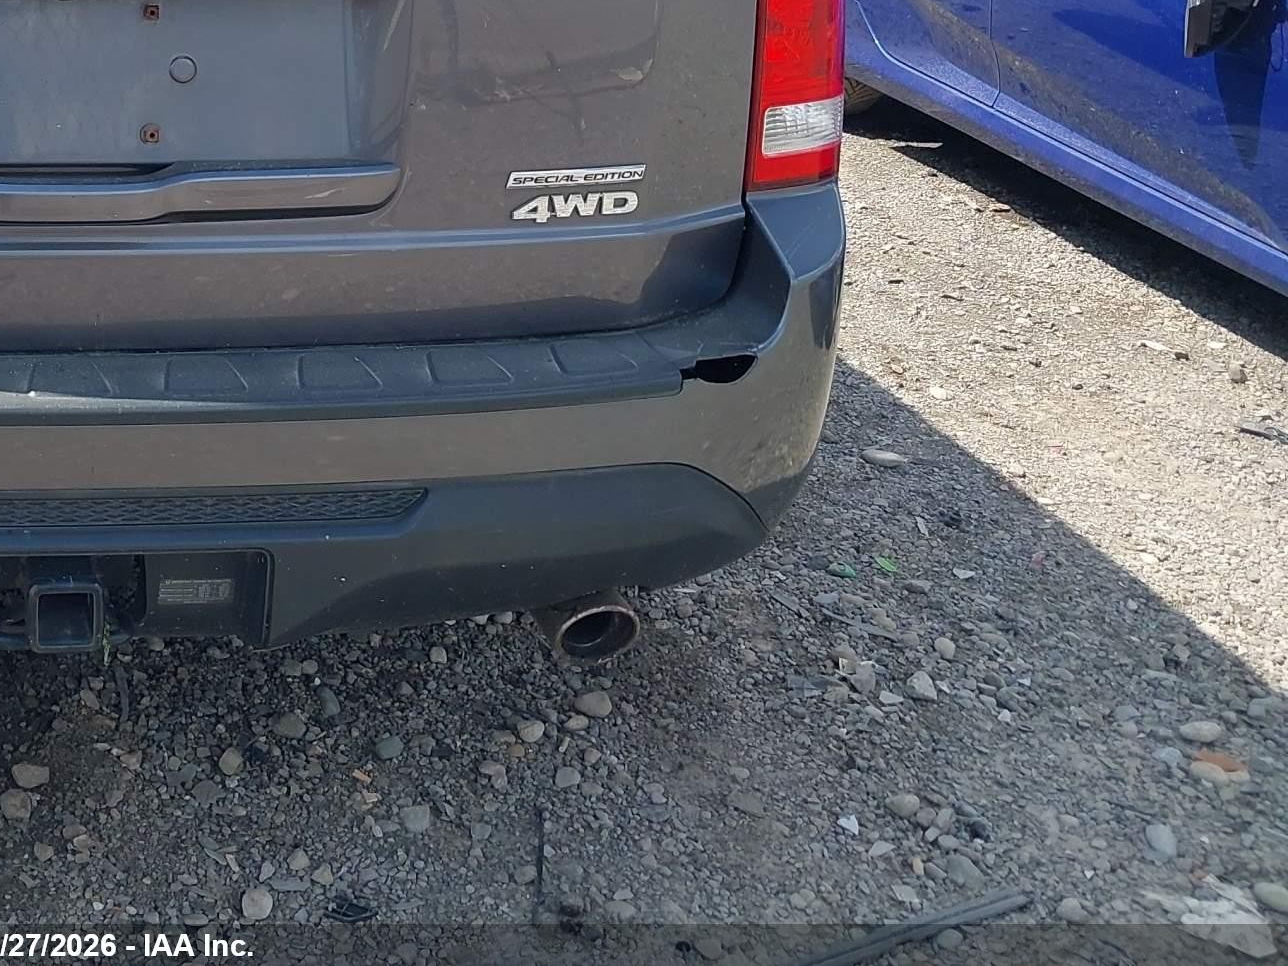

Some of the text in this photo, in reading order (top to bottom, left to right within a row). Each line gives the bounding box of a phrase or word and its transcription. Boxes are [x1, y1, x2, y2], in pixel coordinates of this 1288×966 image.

[512, 169, 644, 185] SPECIAL EDITION
[512, 190, 639, 223] 4WD
